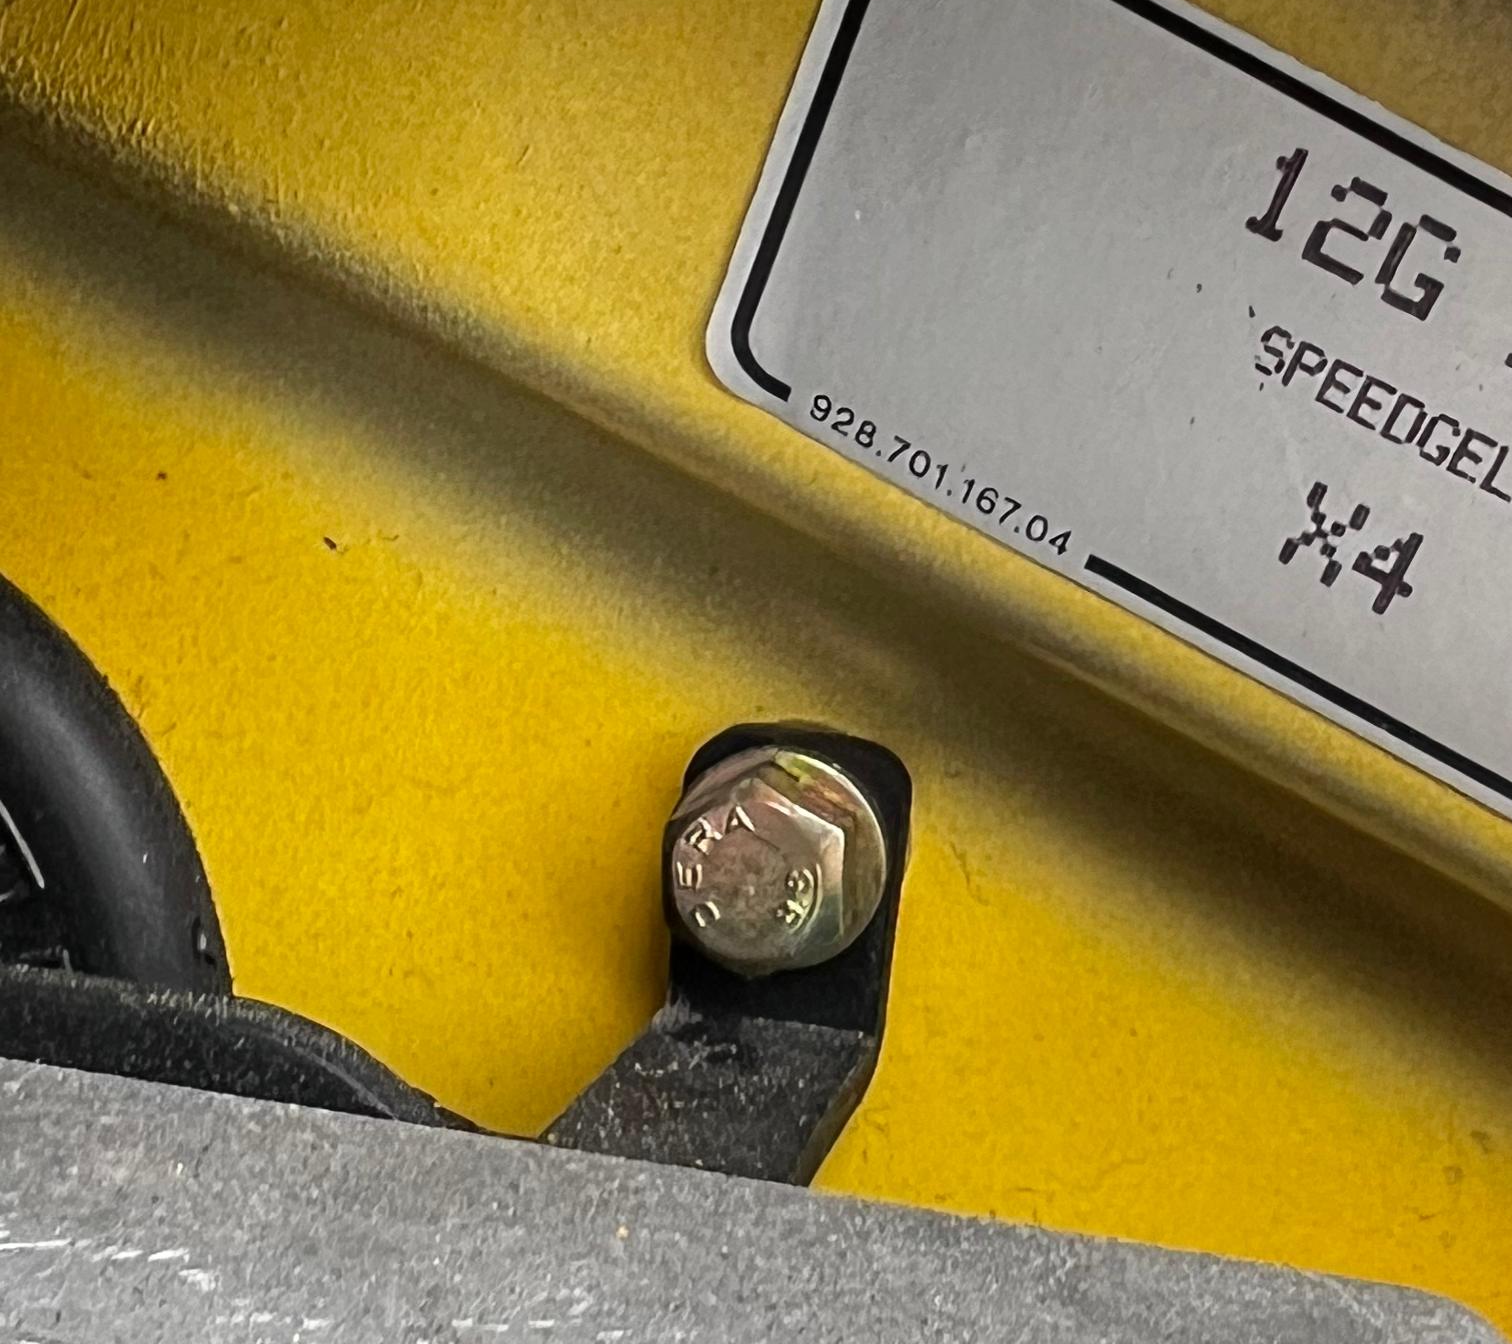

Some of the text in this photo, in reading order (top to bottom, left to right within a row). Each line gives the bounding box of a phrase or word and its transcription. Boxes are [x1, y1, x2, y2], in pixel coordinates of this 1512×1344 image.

[1245, 148, 1461, 321] 12G
[810, 394, 1072, 555] 928.701.167.04
[1278, 481, 1424, 615] X4
